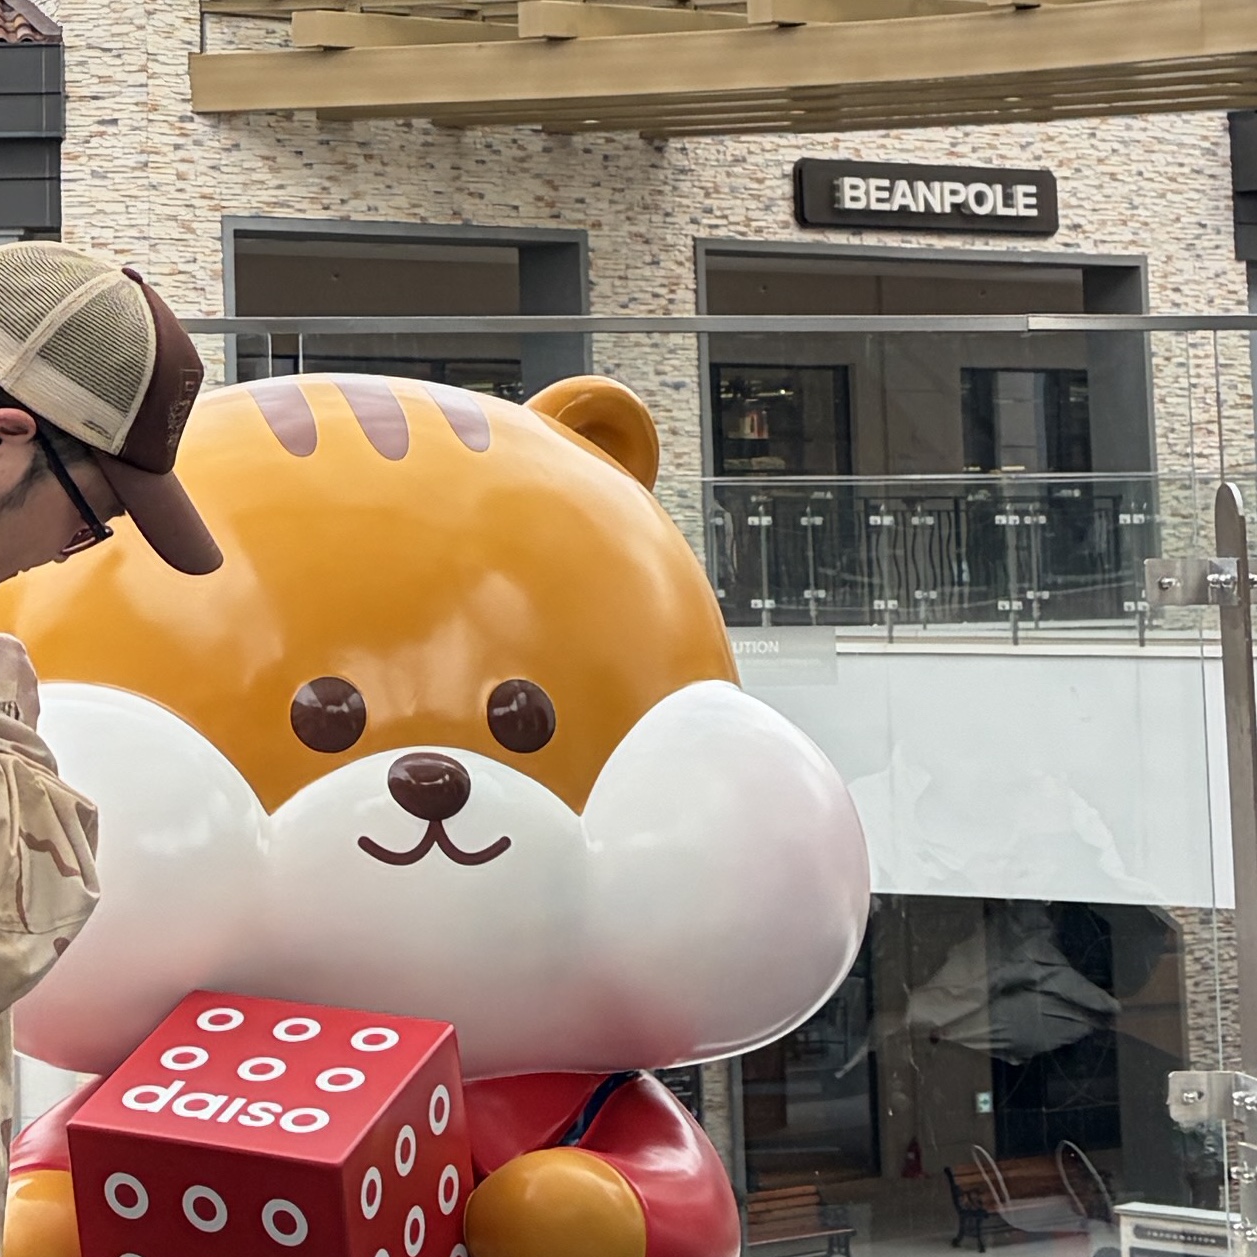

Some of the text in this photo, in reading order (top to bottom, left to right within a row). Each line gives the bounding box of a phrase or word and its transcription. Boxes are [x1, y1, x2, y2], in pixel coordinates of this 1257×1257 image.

[839, 176, 1039, 217] BEANPOLE
[731, 640, 779, 653] UTION
[121, 1079, 330, 1133] daiso
